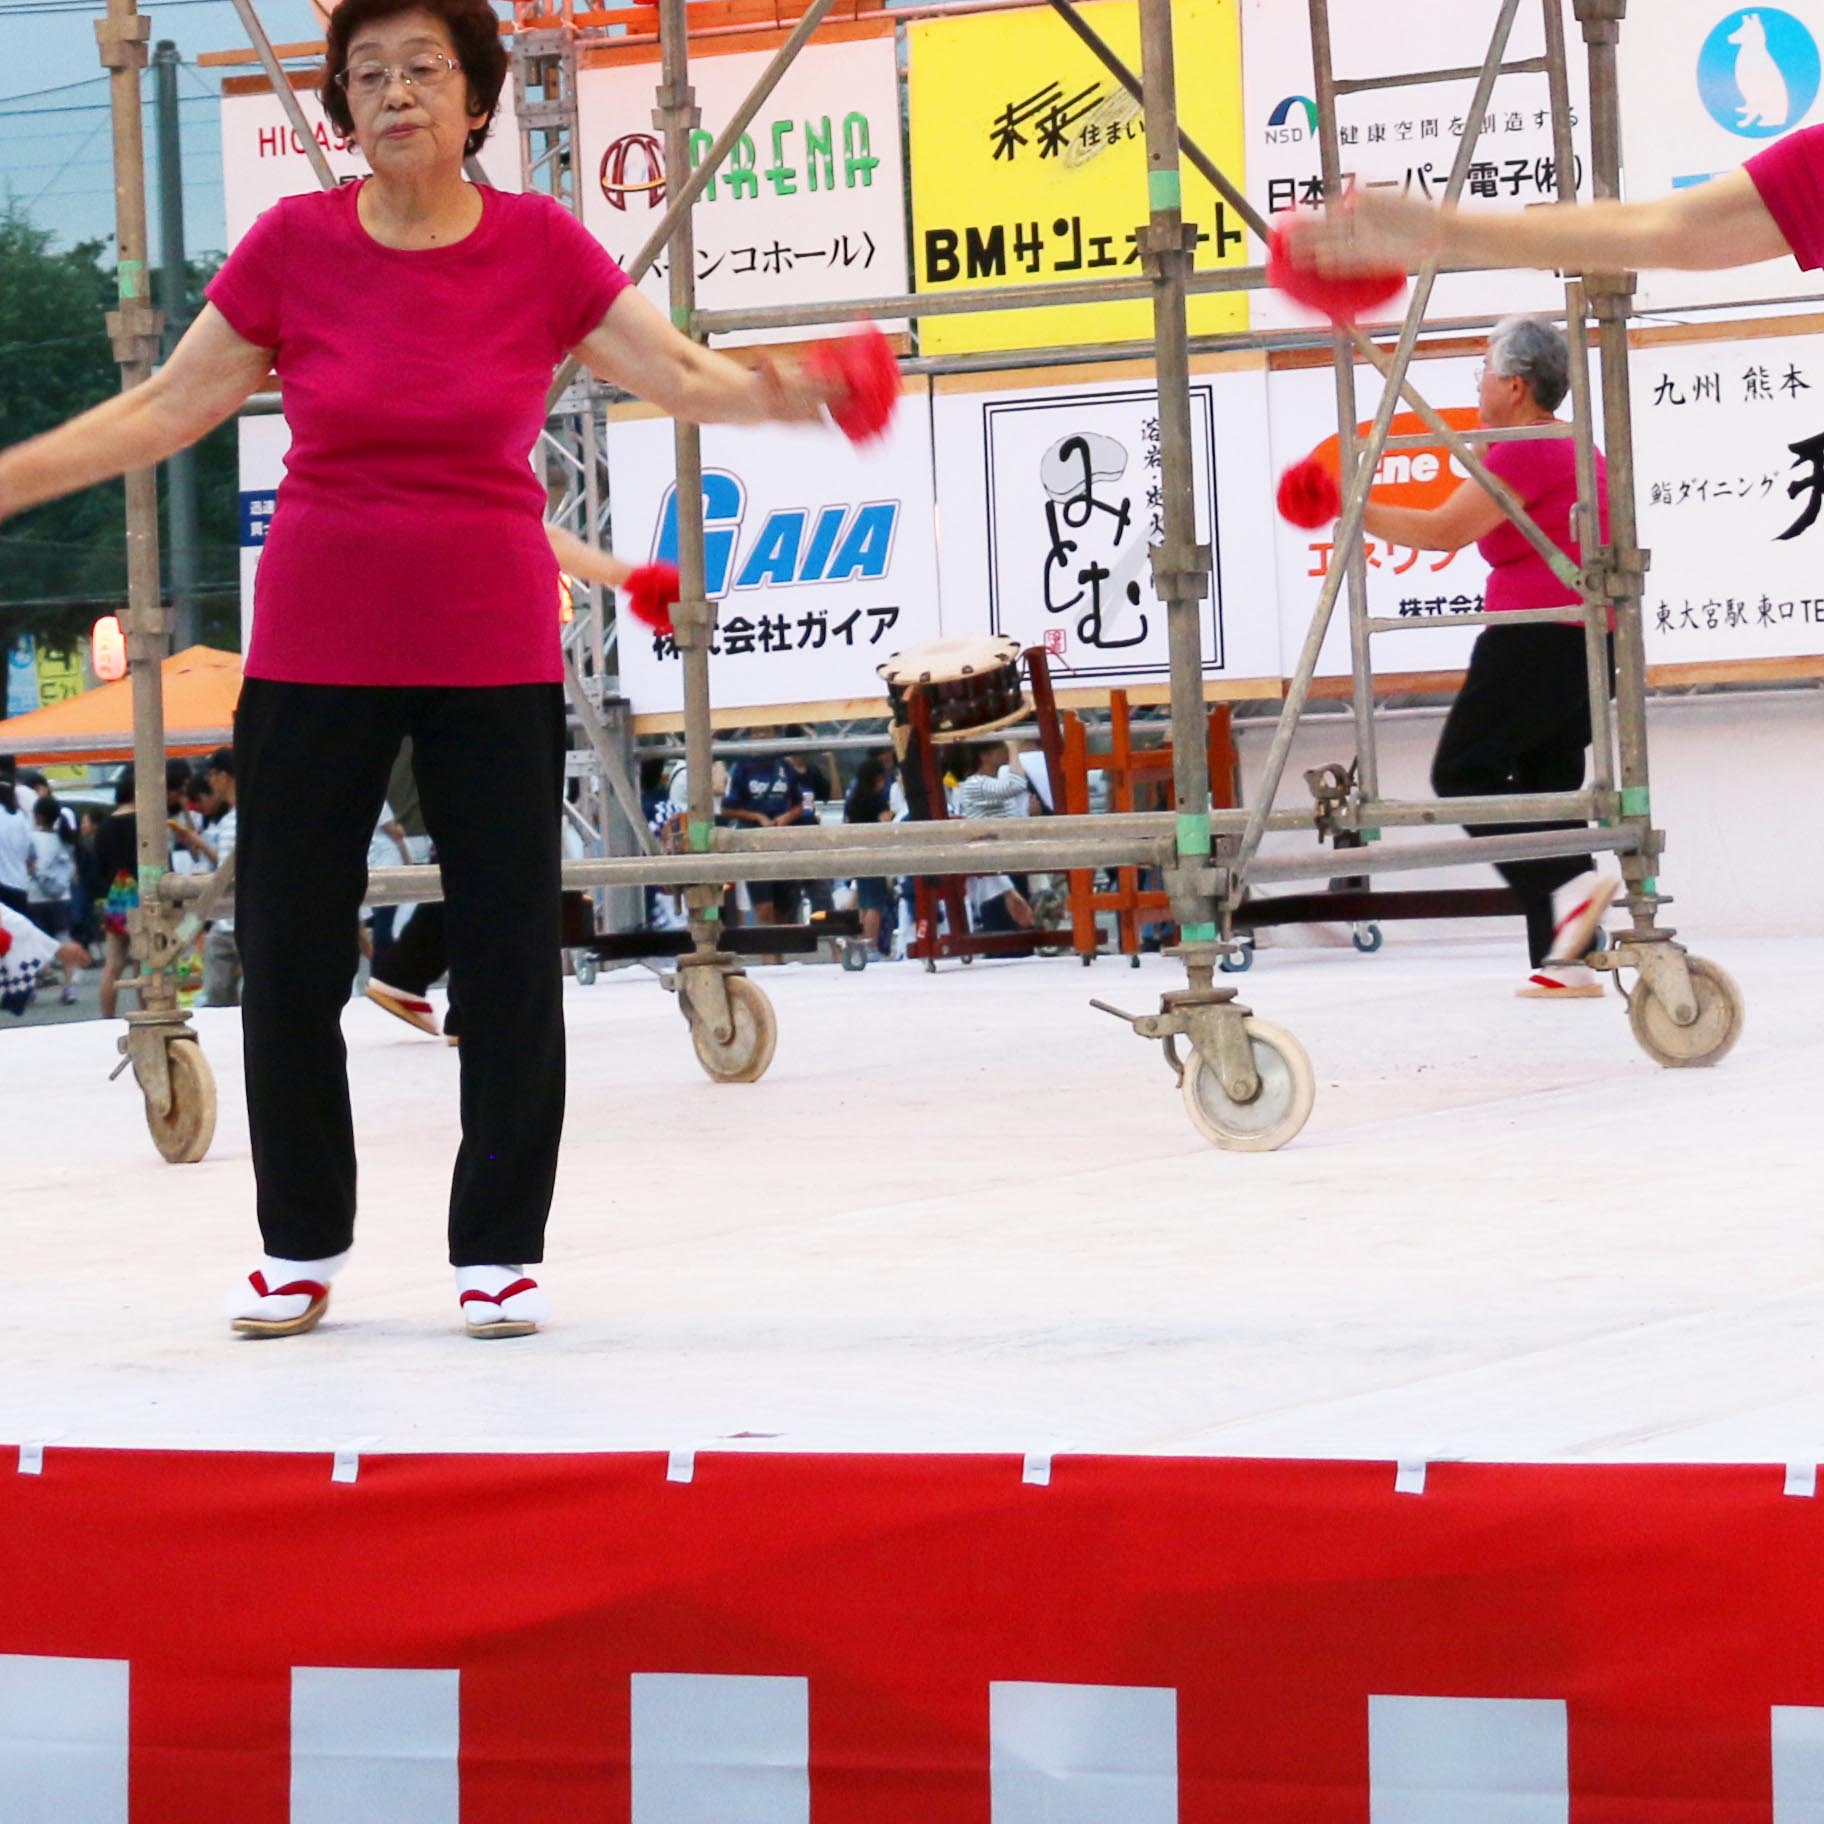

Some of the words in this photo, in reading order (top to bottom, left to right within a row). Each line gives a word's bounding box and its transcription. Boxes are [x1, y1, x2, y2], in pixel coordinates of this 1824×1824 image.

[1265, 128, 1303, 145] NSD
[1654, 373, 1721, 406] 九州
[1741, 362, 1812, 402] 熊本
[649, 466, 902, 600] GAIA
[653, 605, 900, 662] 株会社ガイア
[1655, 599, 1749, 635] 東大宮駅
[1756, 593, 1795, 627] 東口
